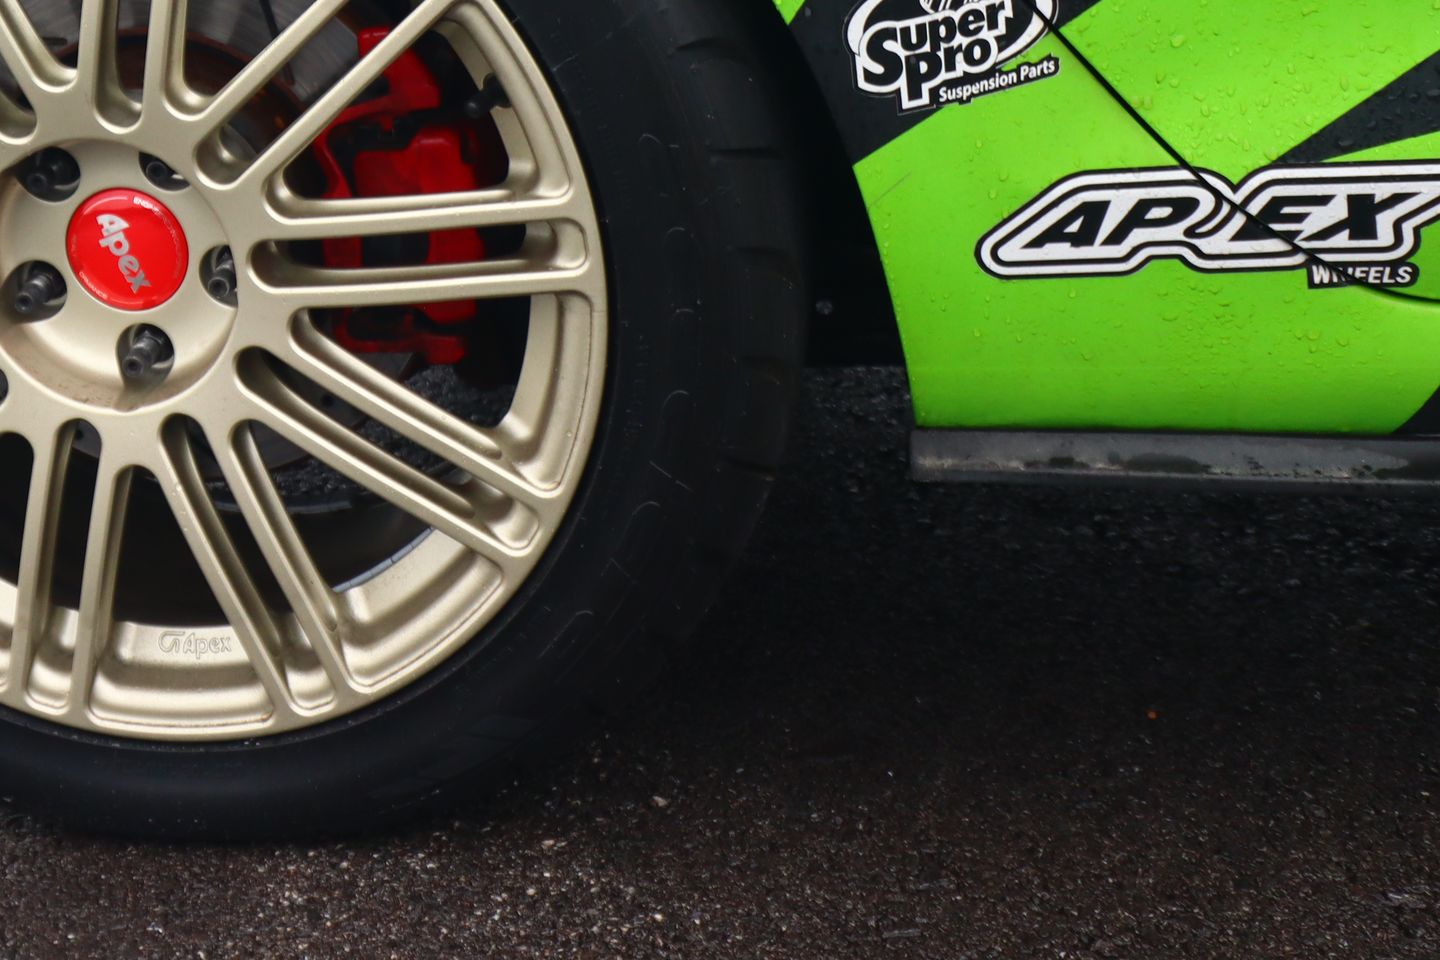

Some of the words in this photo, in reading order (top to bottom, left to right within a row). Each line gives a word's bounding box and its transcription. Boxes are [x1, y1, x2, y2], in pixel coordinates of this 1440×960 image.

[863, 1, 1006, 87] Super
[938, 69, 1018, 103] Suspension
[1020, 58, 1056, 82] Parts
[95, 213, 152, 295] Apex
[1021, 190, 1424, 249] APEX
